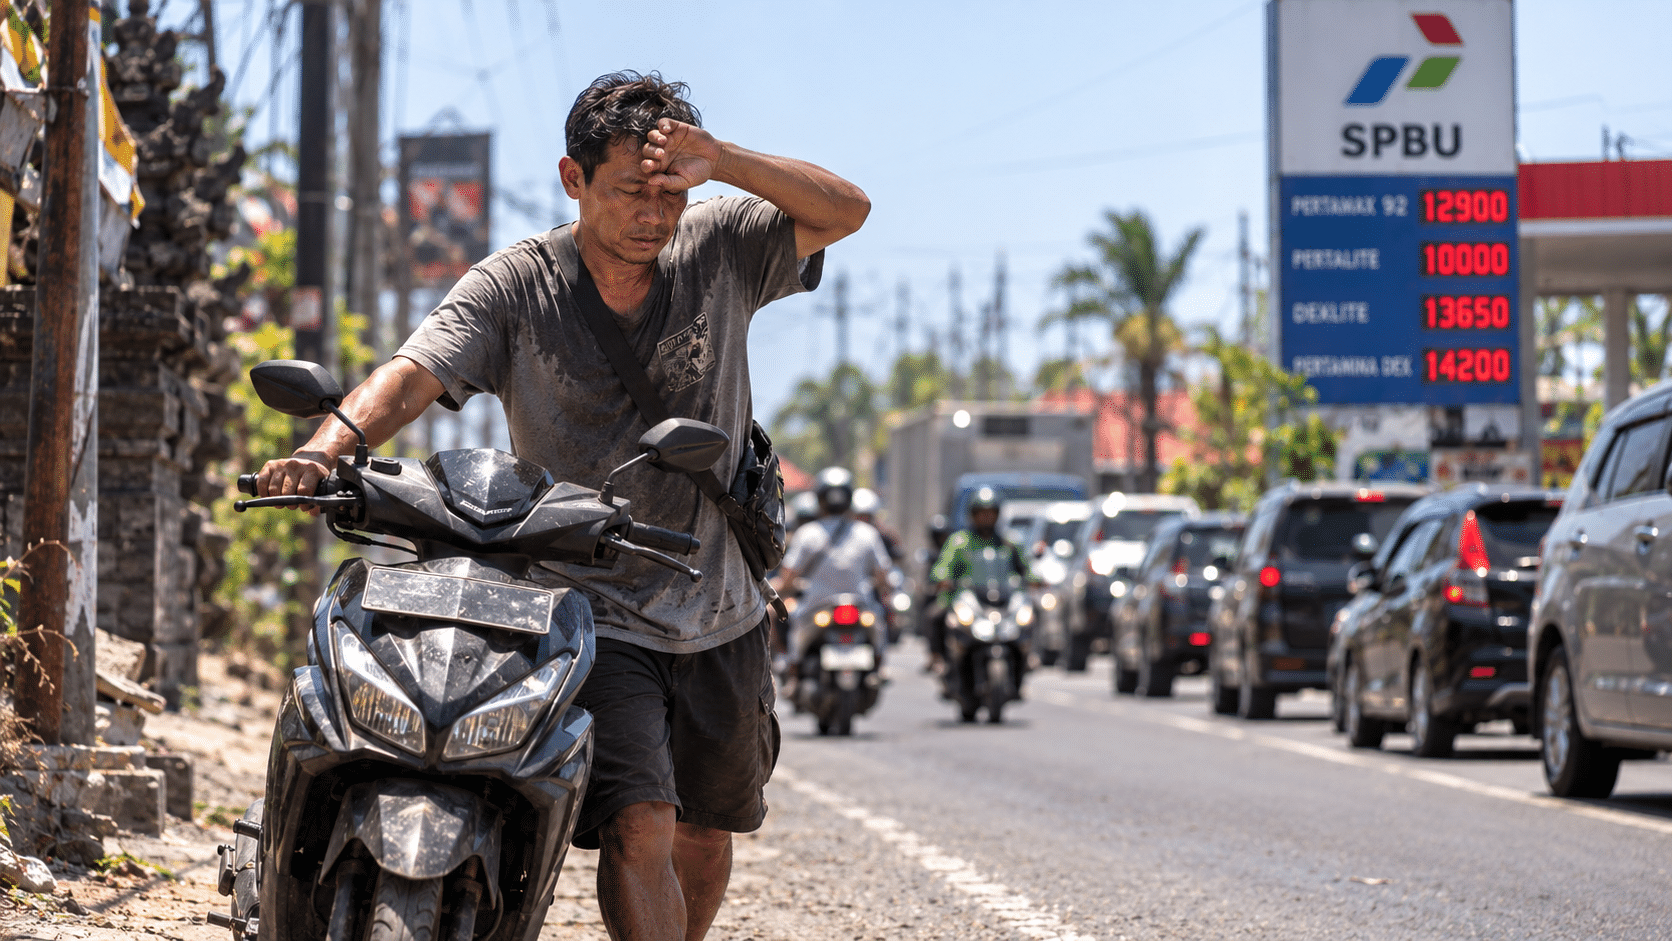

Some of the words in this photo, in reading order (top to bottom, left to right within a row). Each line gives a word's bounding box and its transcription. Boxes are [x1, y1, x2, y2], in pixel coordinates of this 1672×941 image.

[1342, 123, 1462, 159] SPBU
[1291, 195, 1376, 216] PERTAMAX
[1382, 194, 1408, 217] 92
[1423, 190, 1509, 223] 12900
[1291, 248, 1380, 270] PERTALITE
[1424, 243, 1510, 276] 10000
[1292, 301, 1369, 324] DEXLITE
[1425, 296, 1510, 329] 13650
[1426, 349, 1511, 382] 14200
